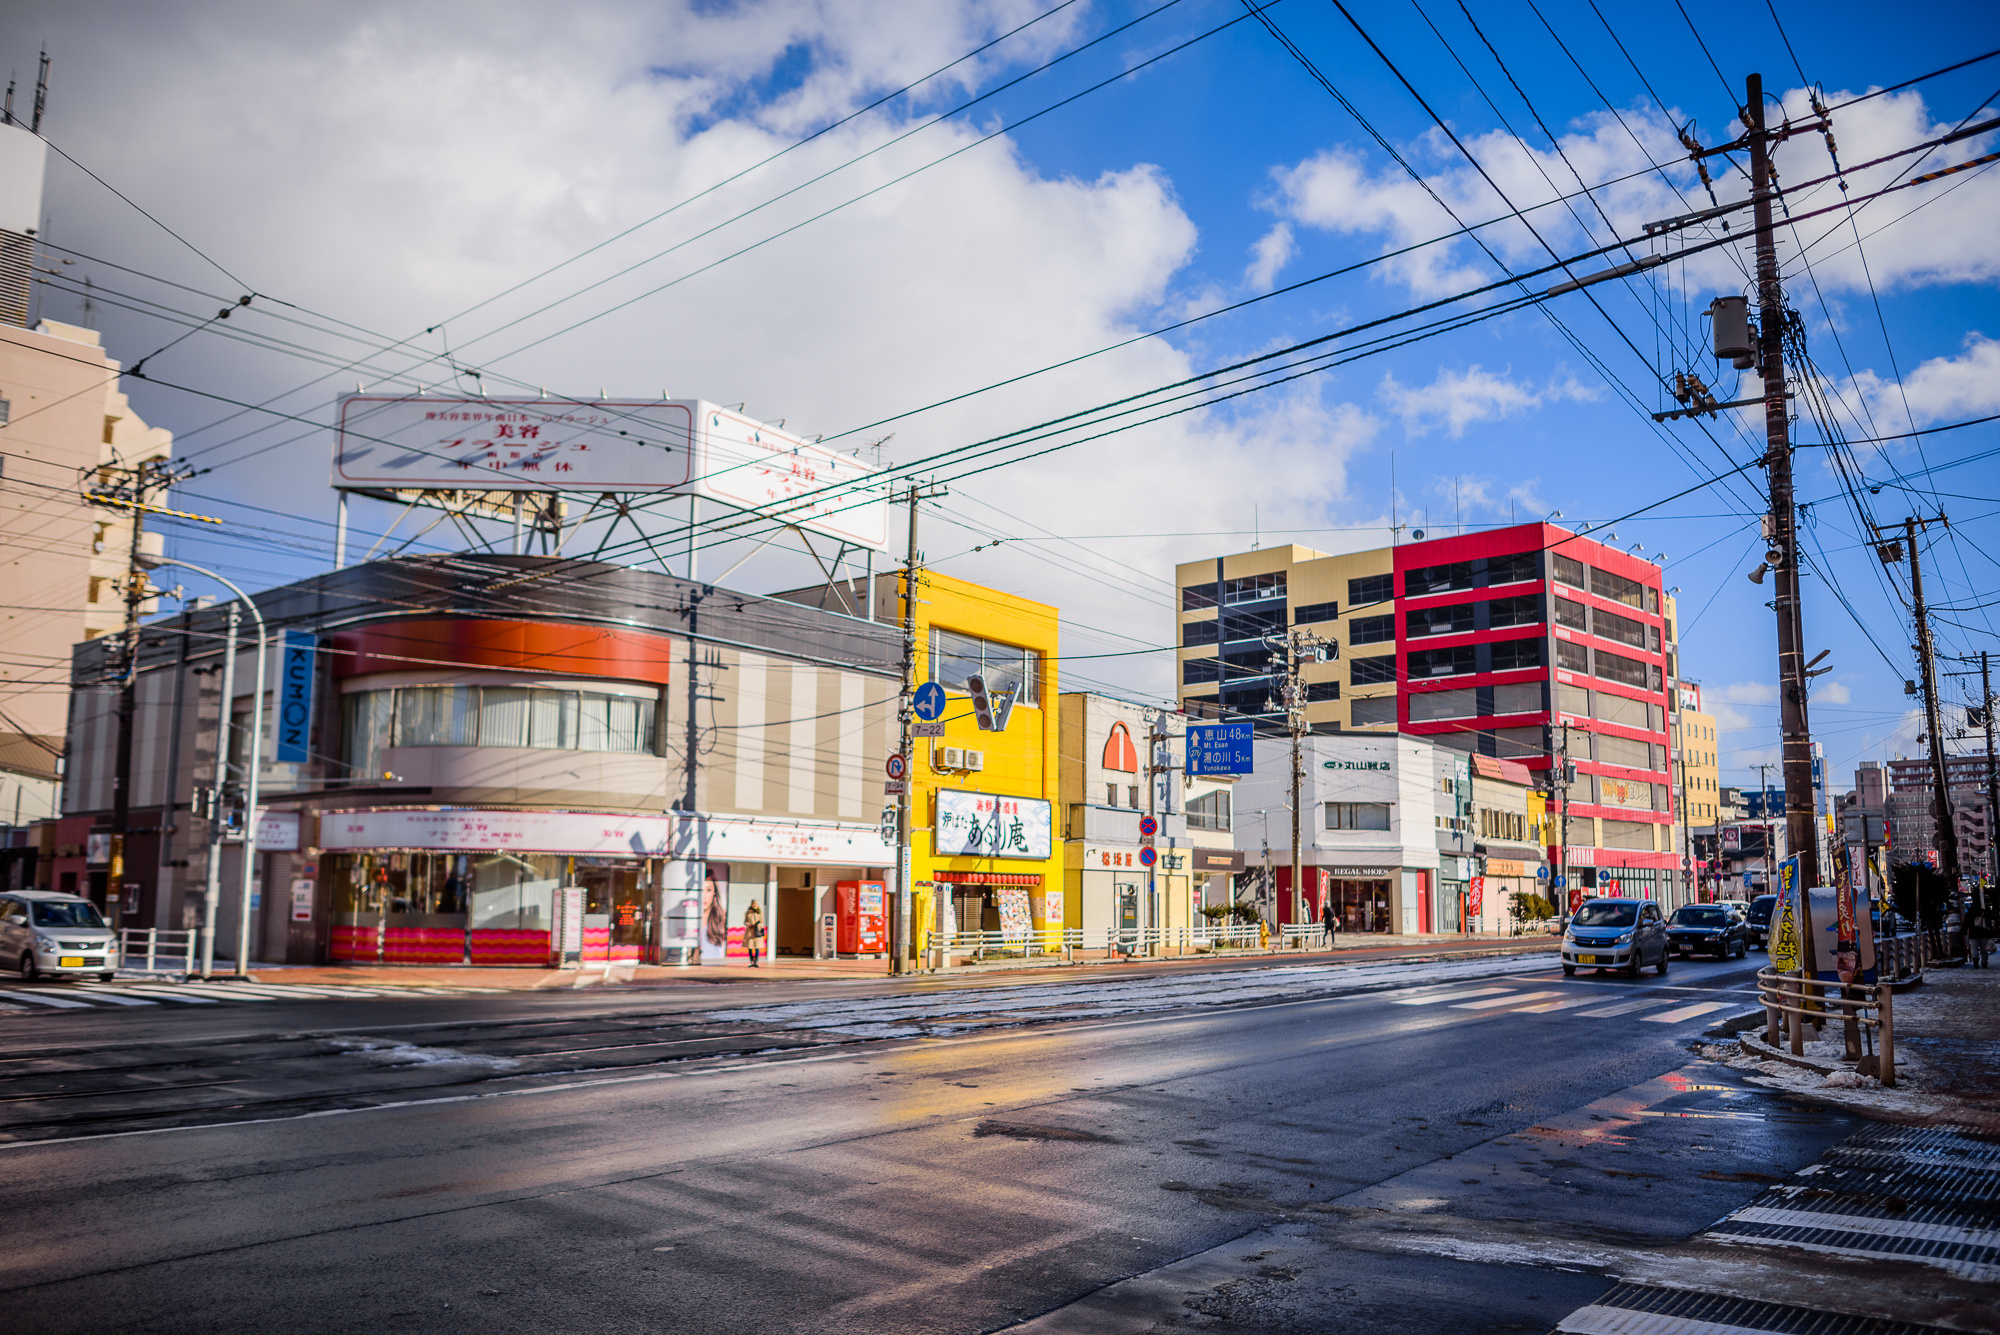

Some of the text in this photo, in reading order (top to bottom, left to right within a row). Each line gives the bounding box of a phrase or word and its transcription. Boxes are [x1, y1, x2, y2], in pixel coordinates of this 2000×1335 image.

[495, 424, 540, 439] 美容
[283, 649, 307, 745] KUMON
[916, 725, 941, 735] 7-22
[1204, 729, 1227, 741] 恵山
